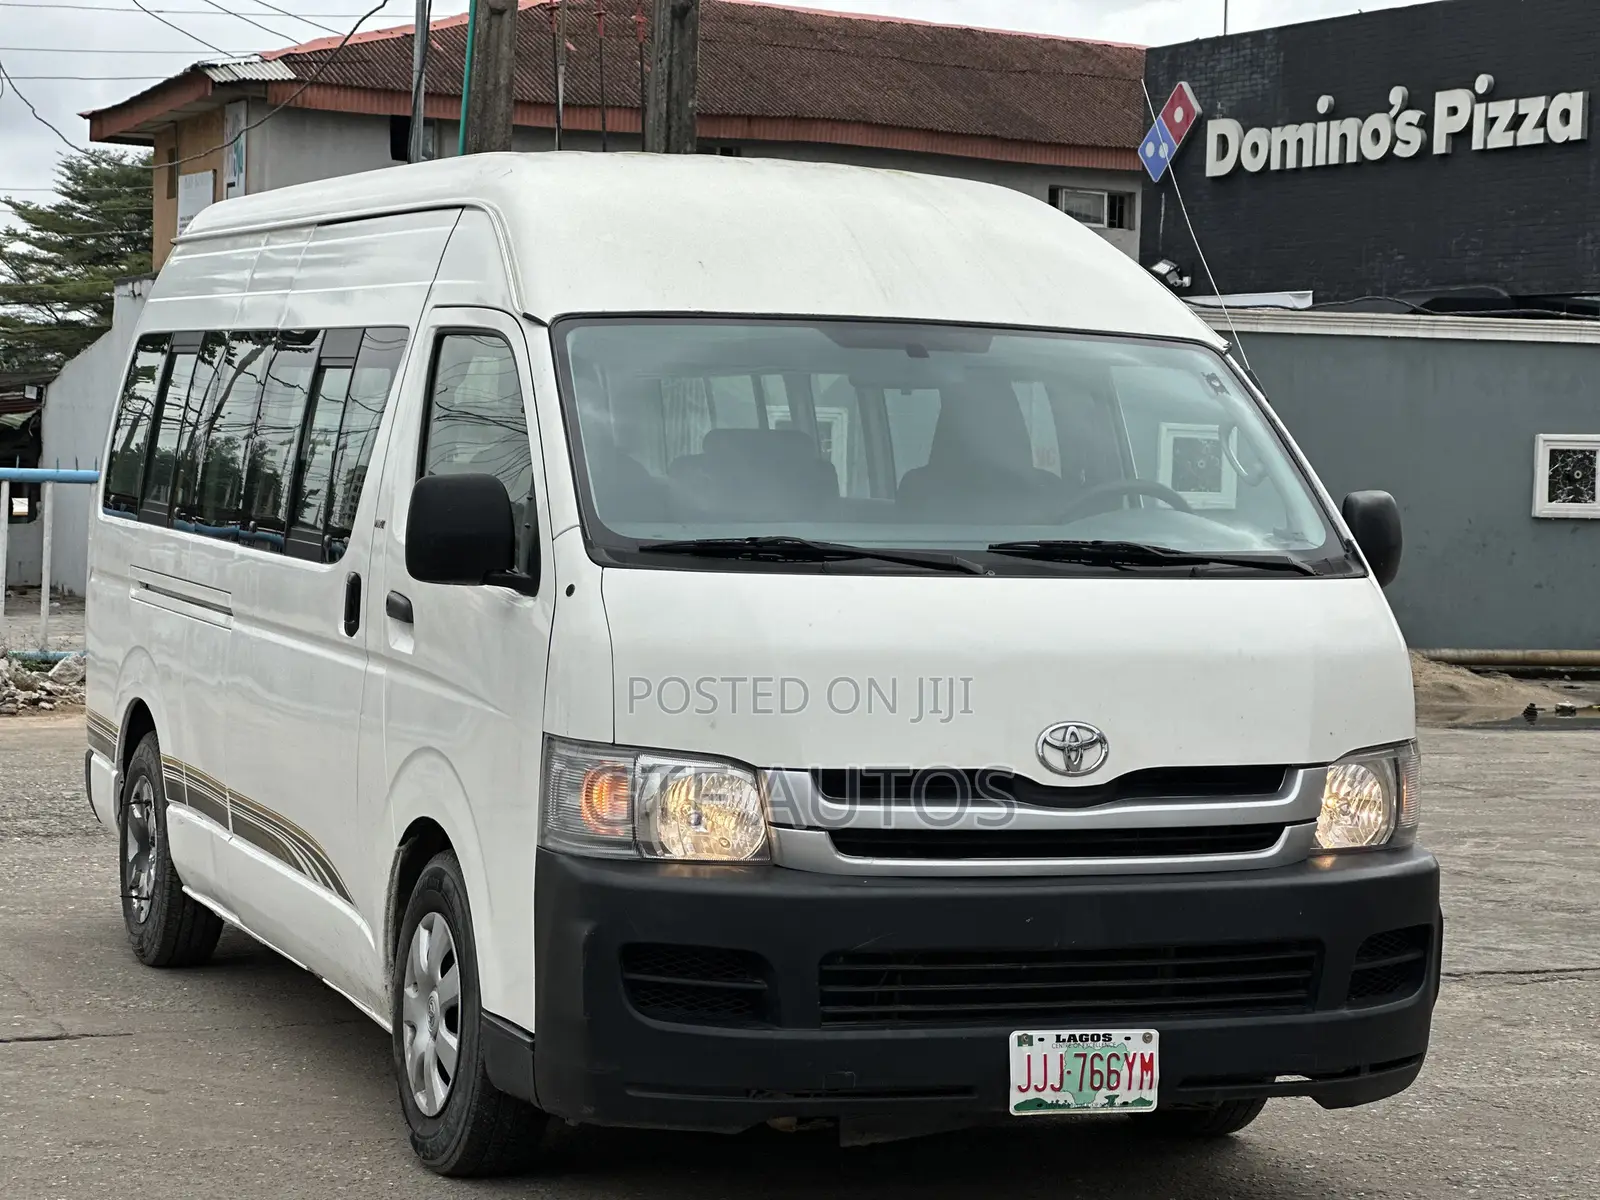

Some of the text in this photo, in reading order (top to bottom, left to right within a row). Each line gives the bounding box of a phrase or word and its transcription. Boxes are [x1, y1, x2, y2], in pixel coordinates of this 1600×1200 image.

[1206, 74, 1589, 177] Domino's Pizza
[1055, 1033, 1113, 1043] LAGOS
